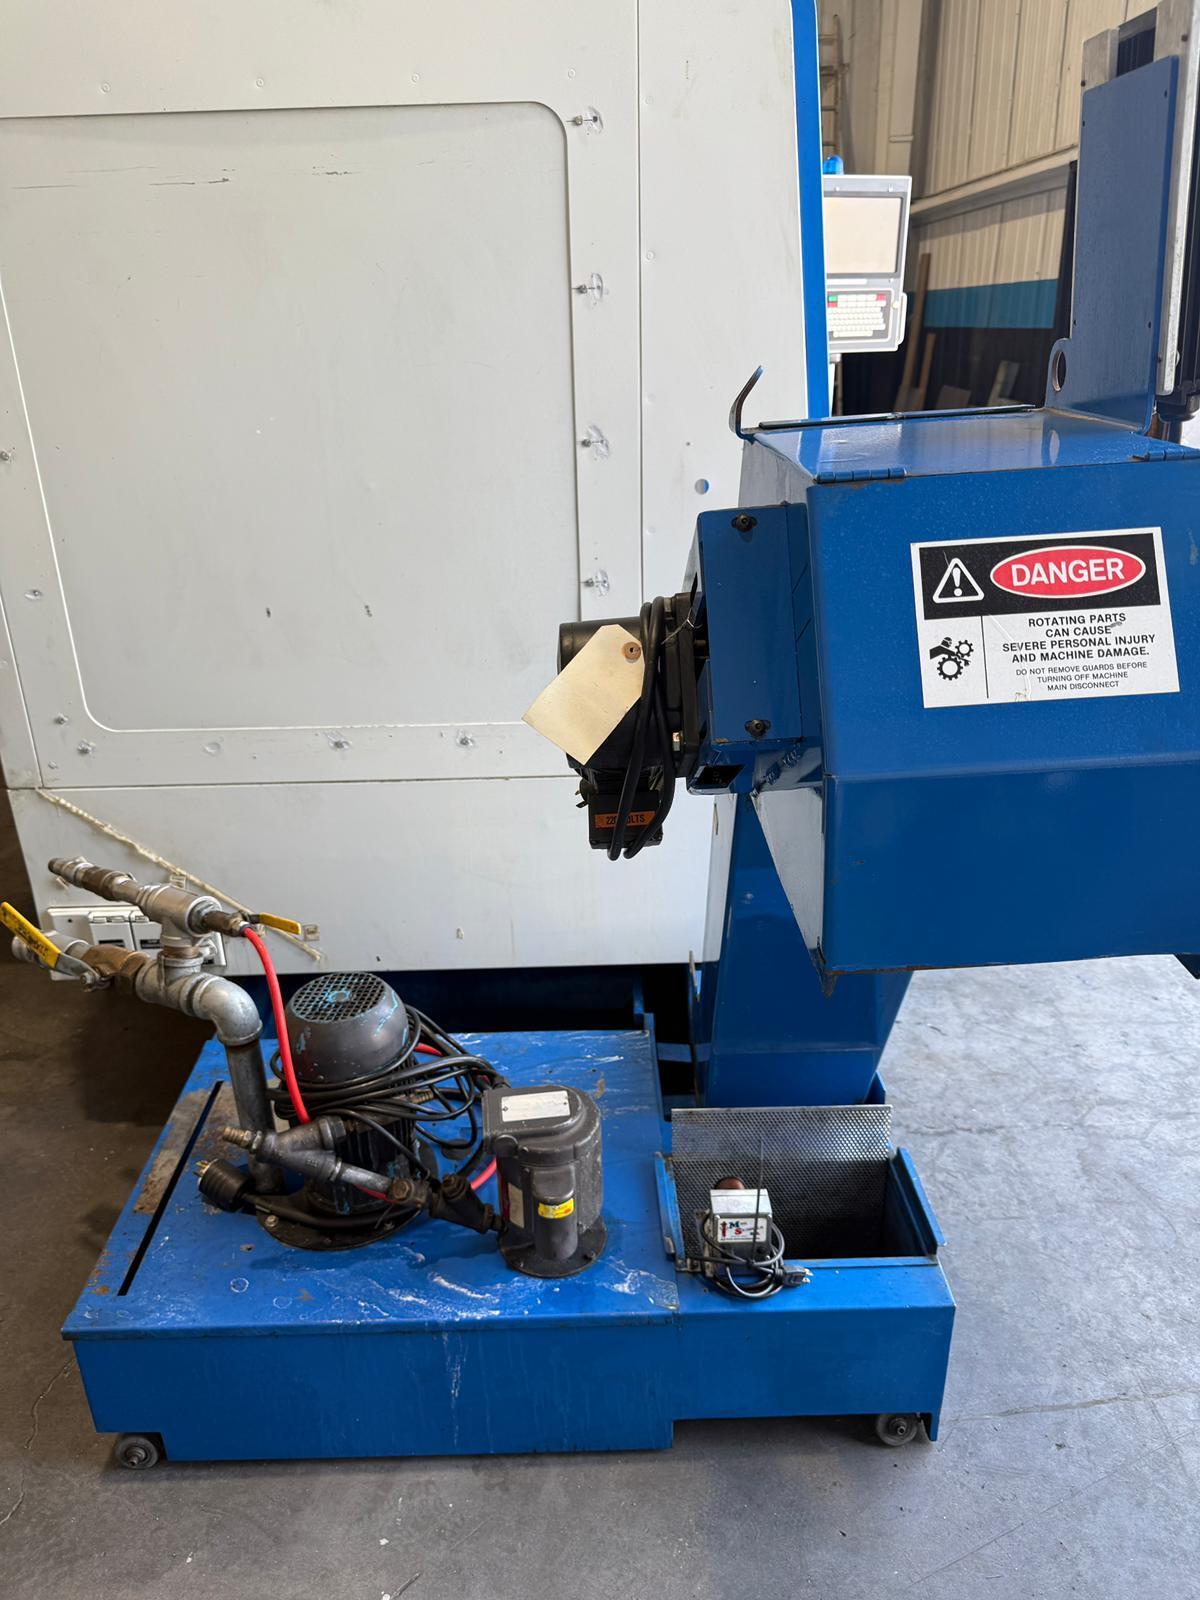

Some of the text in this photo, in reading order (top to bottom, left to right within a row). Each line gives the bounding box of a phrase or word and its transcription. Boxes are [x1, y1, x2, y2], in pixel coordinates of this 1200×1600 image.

[1011, 558, 1124, 587] DANGER
[1028, 612, 1126, 627] ROTATING PARTS
[1045, 626, 1112, 638] CAN CAUSE
[1002, 633, 1156, 652] SEVERE PERSONAL INJURY
[1012, 646, 1150, 663] AND MACHINE DAMAGE.
[1016, 661, 1148, 676] DO NOT REMOVE GUARDS BEFORE
[1037, 671, 1129, 684] TURNING OFF MACHINE
[1047, 680, 1120, 692] MAIN DISCONNECT
[627, 814, 645, 824] OLTS
